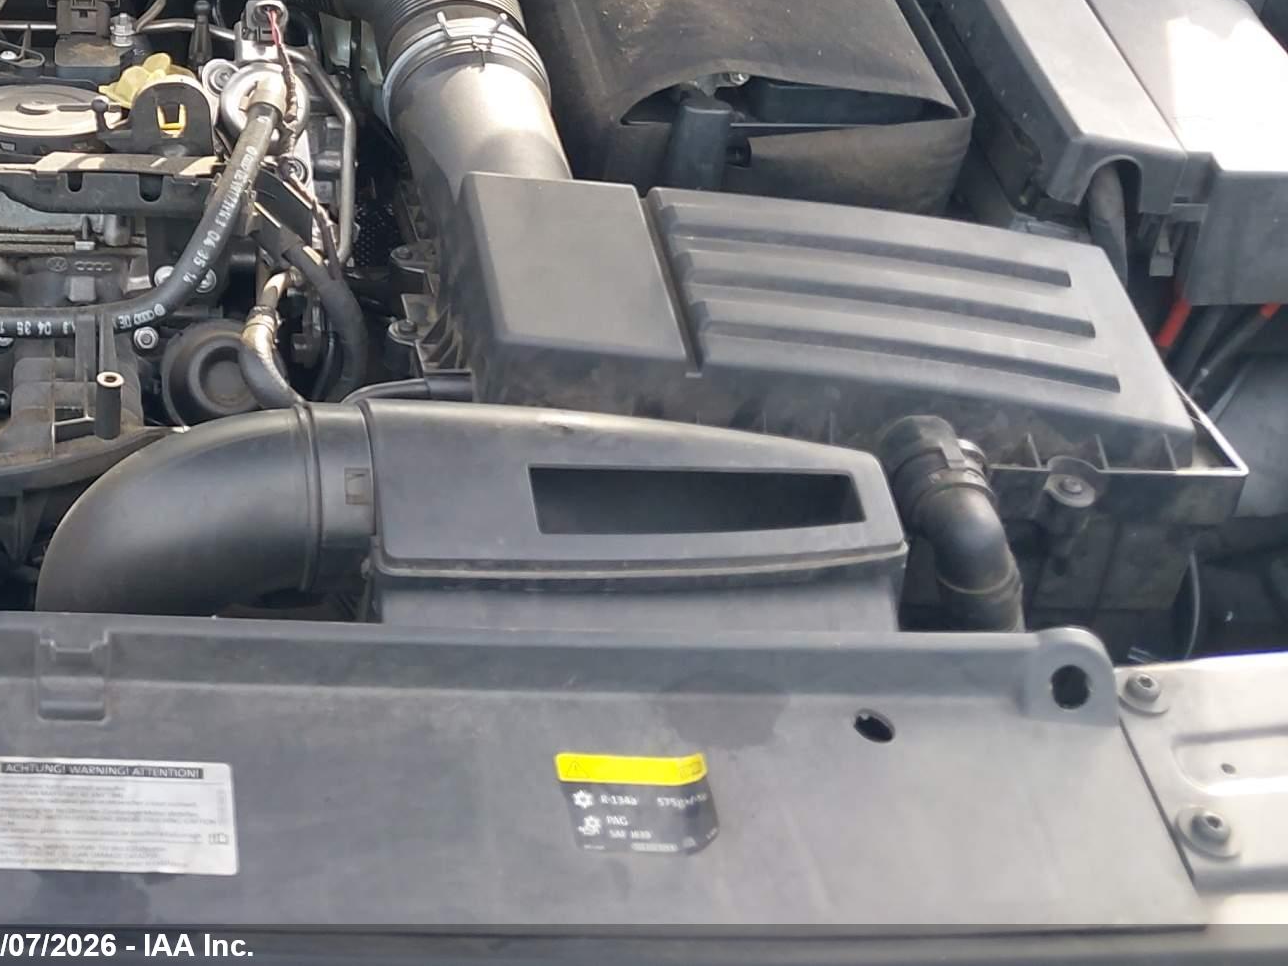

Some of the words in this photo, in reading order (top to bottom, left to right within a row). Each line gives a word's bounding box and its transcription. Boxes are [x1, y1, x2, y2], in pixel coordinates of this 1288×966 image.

[4, 762, 66, 774] ACHTUNG!
[69, 765, 129, 776] WARNING!
[131, 767, 201, 779] ATTENTION!
[605, 814, 629, 827] PAG
